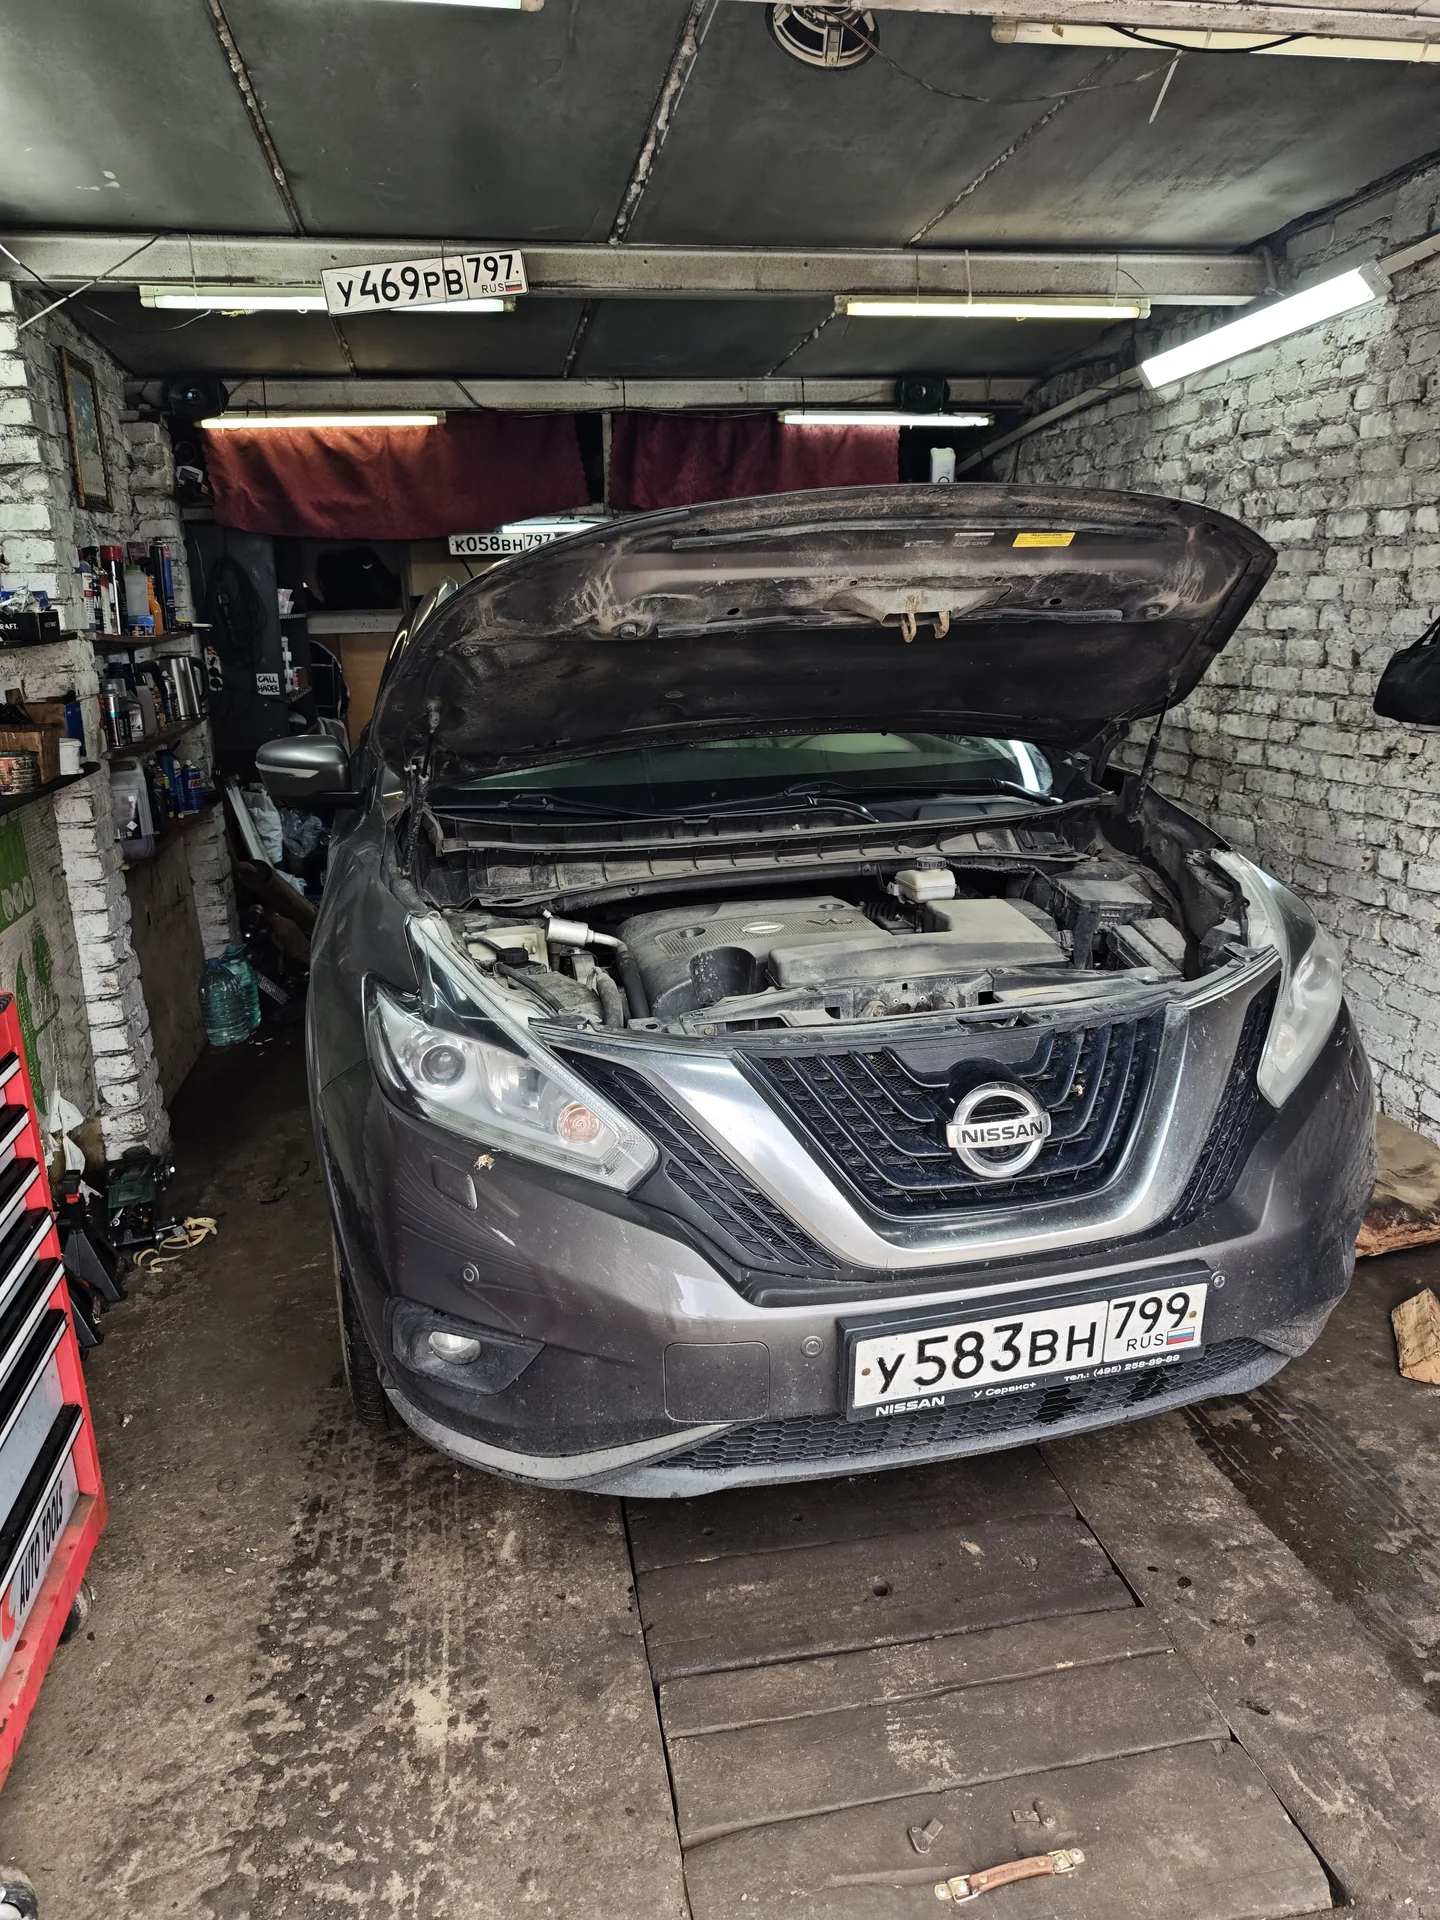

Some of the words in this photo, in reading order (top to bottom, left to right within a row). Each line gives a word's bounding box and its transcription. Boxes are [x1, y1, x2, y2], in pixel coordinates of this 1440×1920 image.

[467, 254, 513, 283] 797
[481, 283, 505, 294] RUS
[525, 534, 551, 547] 797
[961, 1120, 1043, 1143] NISSAN
[1112, 1292, 1191, 1340] 799
[1126, 1333, 1164, 1352] RUS
[875, 1396, 945, 1416] NISSAN
[19, 1531, 41, 1617] AUTO
[42, 1480, 63, 1562] TOOLS
